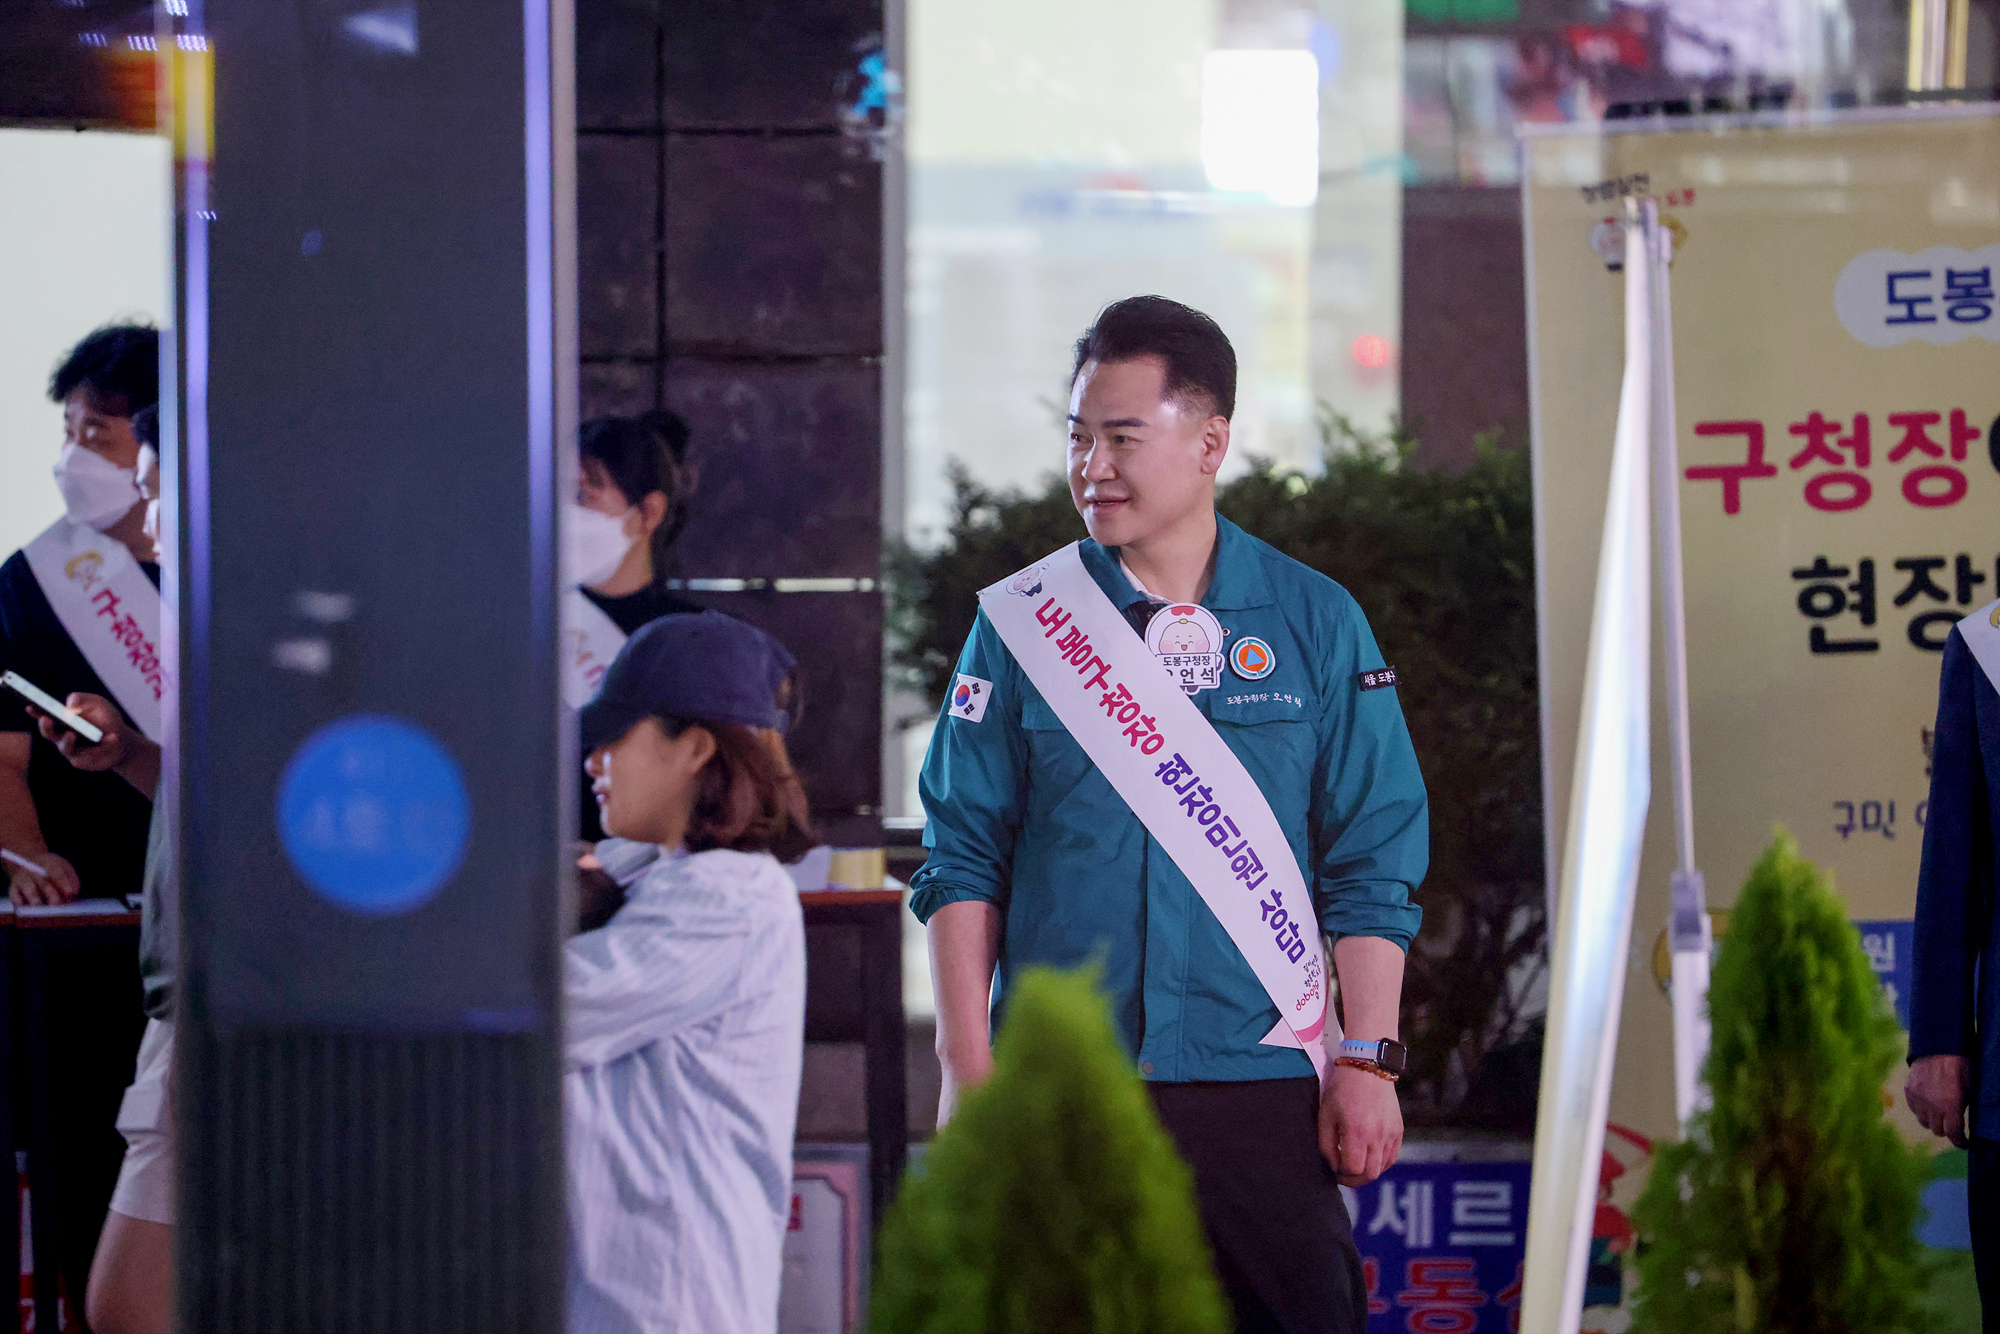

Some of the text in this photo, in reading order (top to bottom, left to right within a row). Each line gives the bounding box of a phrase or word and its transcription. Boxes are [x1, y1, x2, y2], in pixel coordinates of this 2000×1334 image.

[1685, 407, 2000, 514] 구청장
[1792, 554, 2000, 653] 현장
[1163, 655, 1211, 667] 도봉구청장
[1166, 667, 1215, 684] 언석
[1035, 597, 1305, 964] 도봉구청장 현장민원 상담
[1833, 800, 1896, 840] 구민
